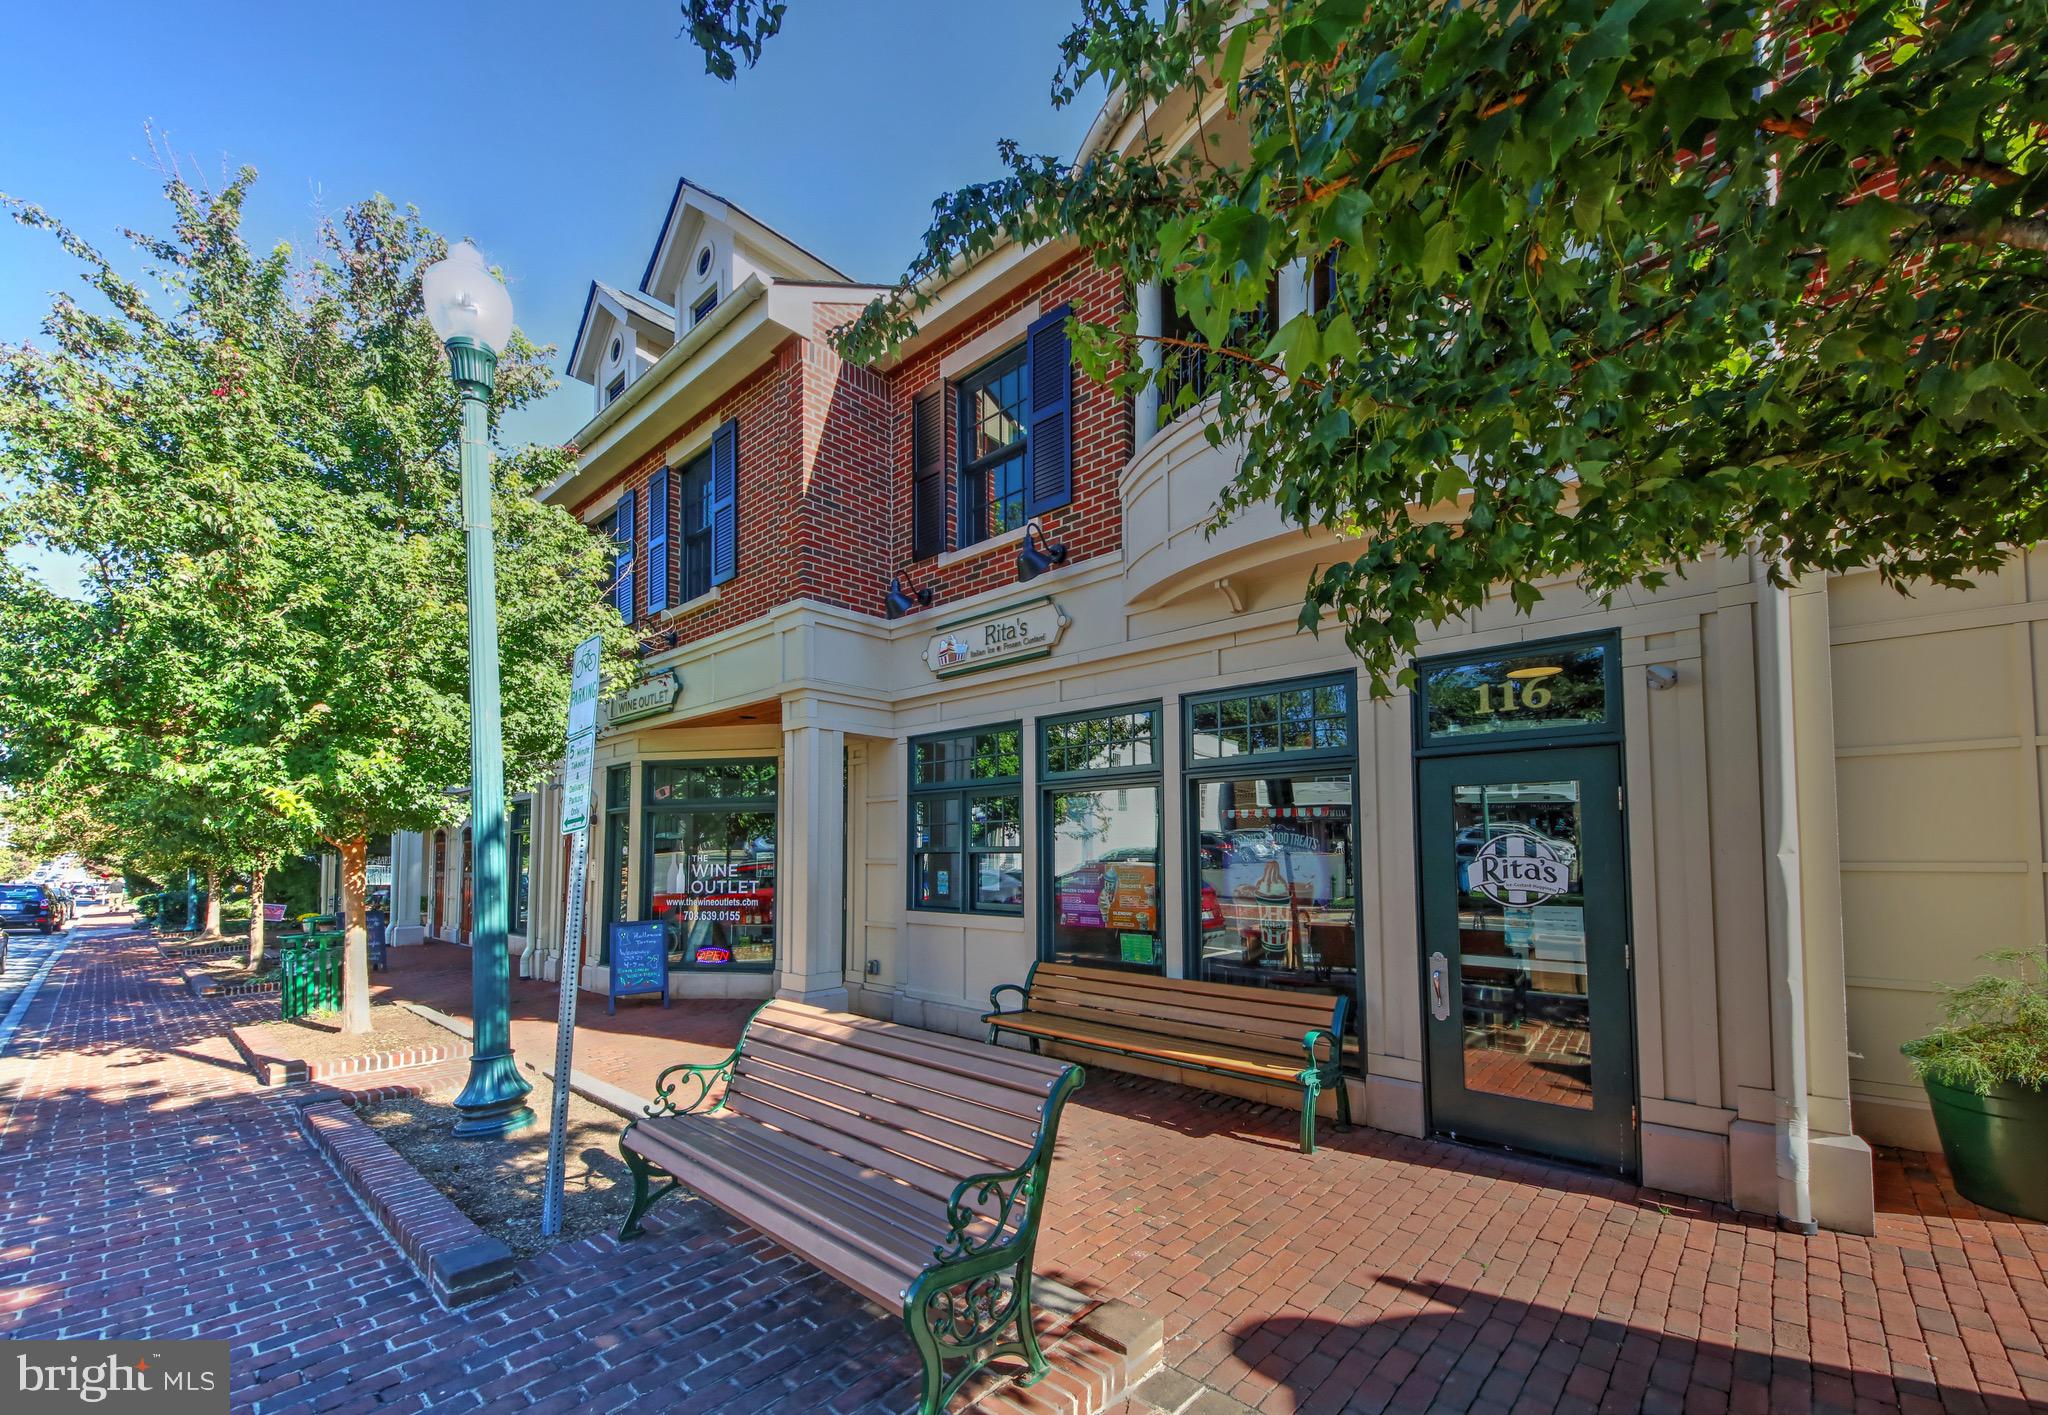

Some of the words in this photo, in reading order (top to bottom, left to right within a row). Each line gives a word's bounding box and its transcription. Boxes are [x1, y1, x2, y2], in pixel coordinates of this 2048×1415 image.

[985, 618, 1028, 645] Rita's
[1003, 641, 1021, 650] Frozen
[1023, 634, 1046, 644] Custard
[572, 681, 597, 707] PARKING
[619, 698, 638, 714] WINE
[639, 690, 668, 708] OUTLET
[1472, 676, 1552, 714] 116
[570, 745, 574, 760] 5
[1290, 833, 1319, 850] TREATS
[692, 854, 708, 862] THE
[692, 864, 738, 877] WINE
[1482, 858, 1558, 883] Rita's
[691, 880, 759, 894] OUTLET
[666, 898, 759, 906] www.thewineoutlets.com
[696, 950, 729, 961] OPEN
